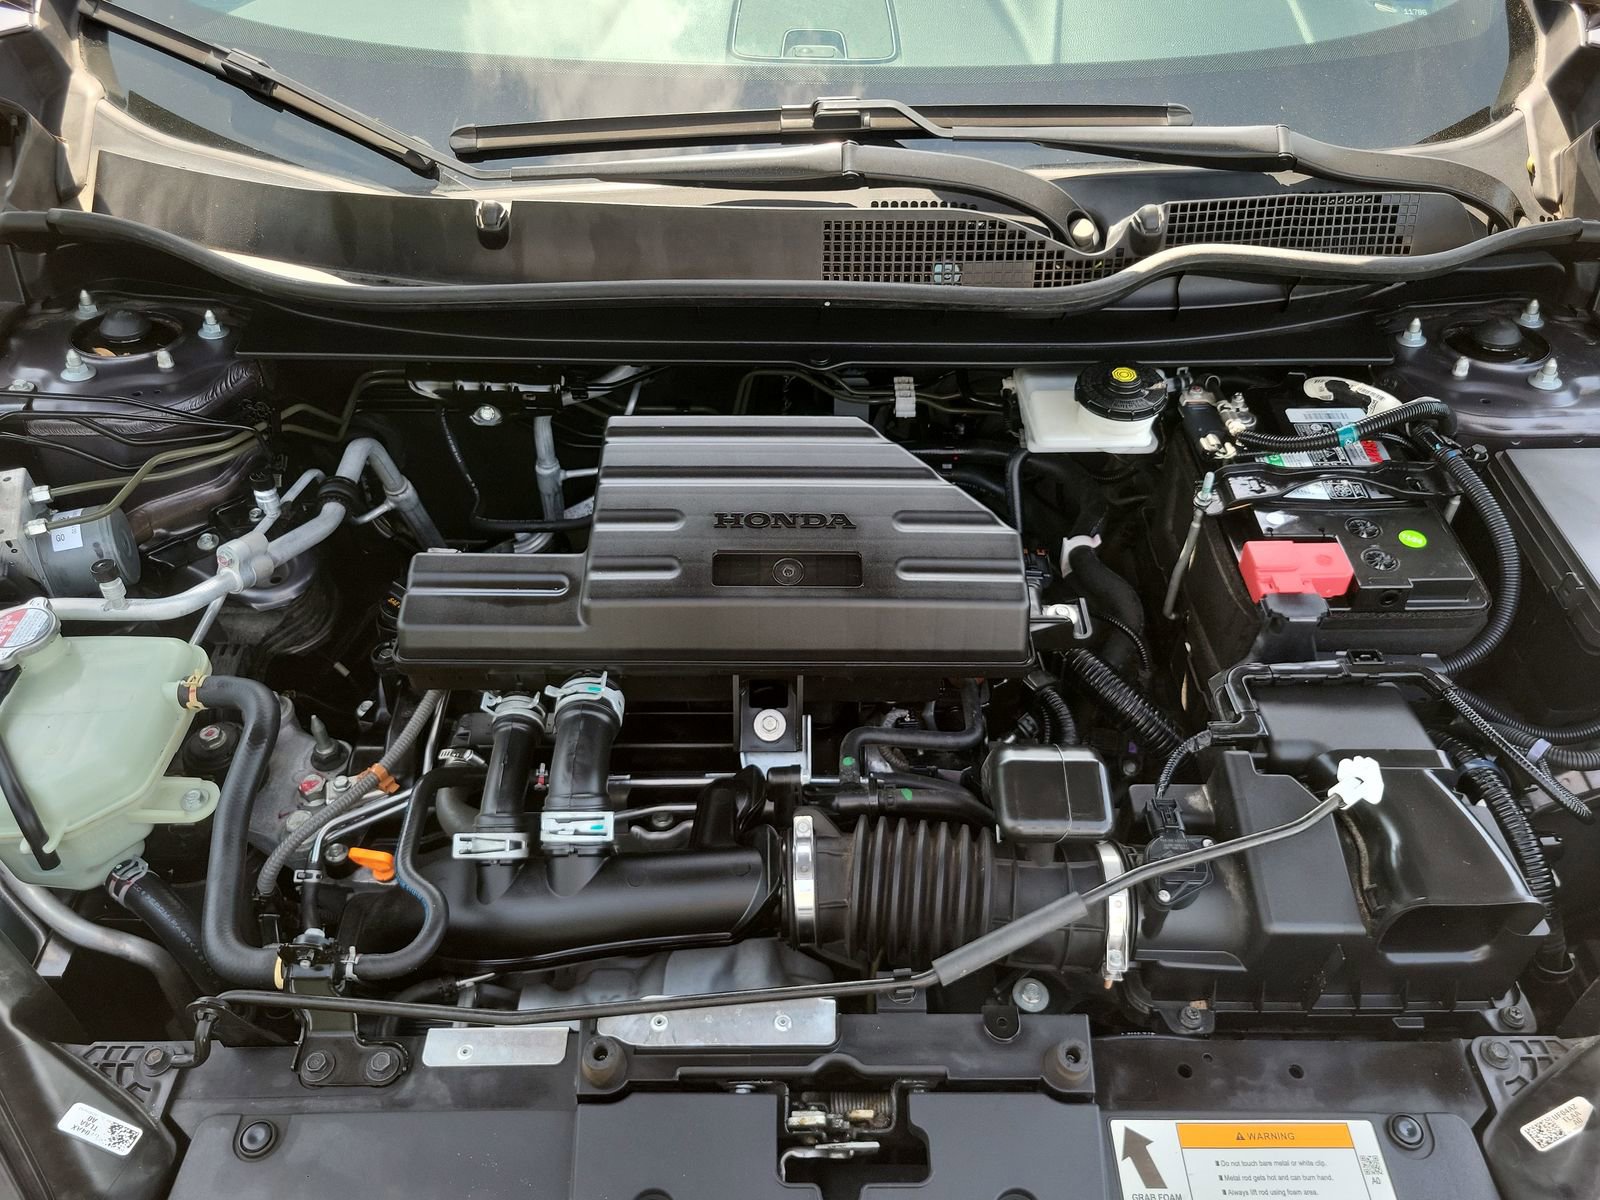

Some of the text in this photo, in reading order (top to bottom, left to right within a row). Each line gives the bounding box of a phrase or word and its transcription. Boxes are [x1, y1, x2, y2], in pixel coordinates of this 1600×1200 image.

[714, 511, 857, 530] HONDA
[1247, 1132, 1296, 1141] WARNING
[1228, 1189, 1249, 1197] Always
[1270, 1189, 1286, 1197] using
